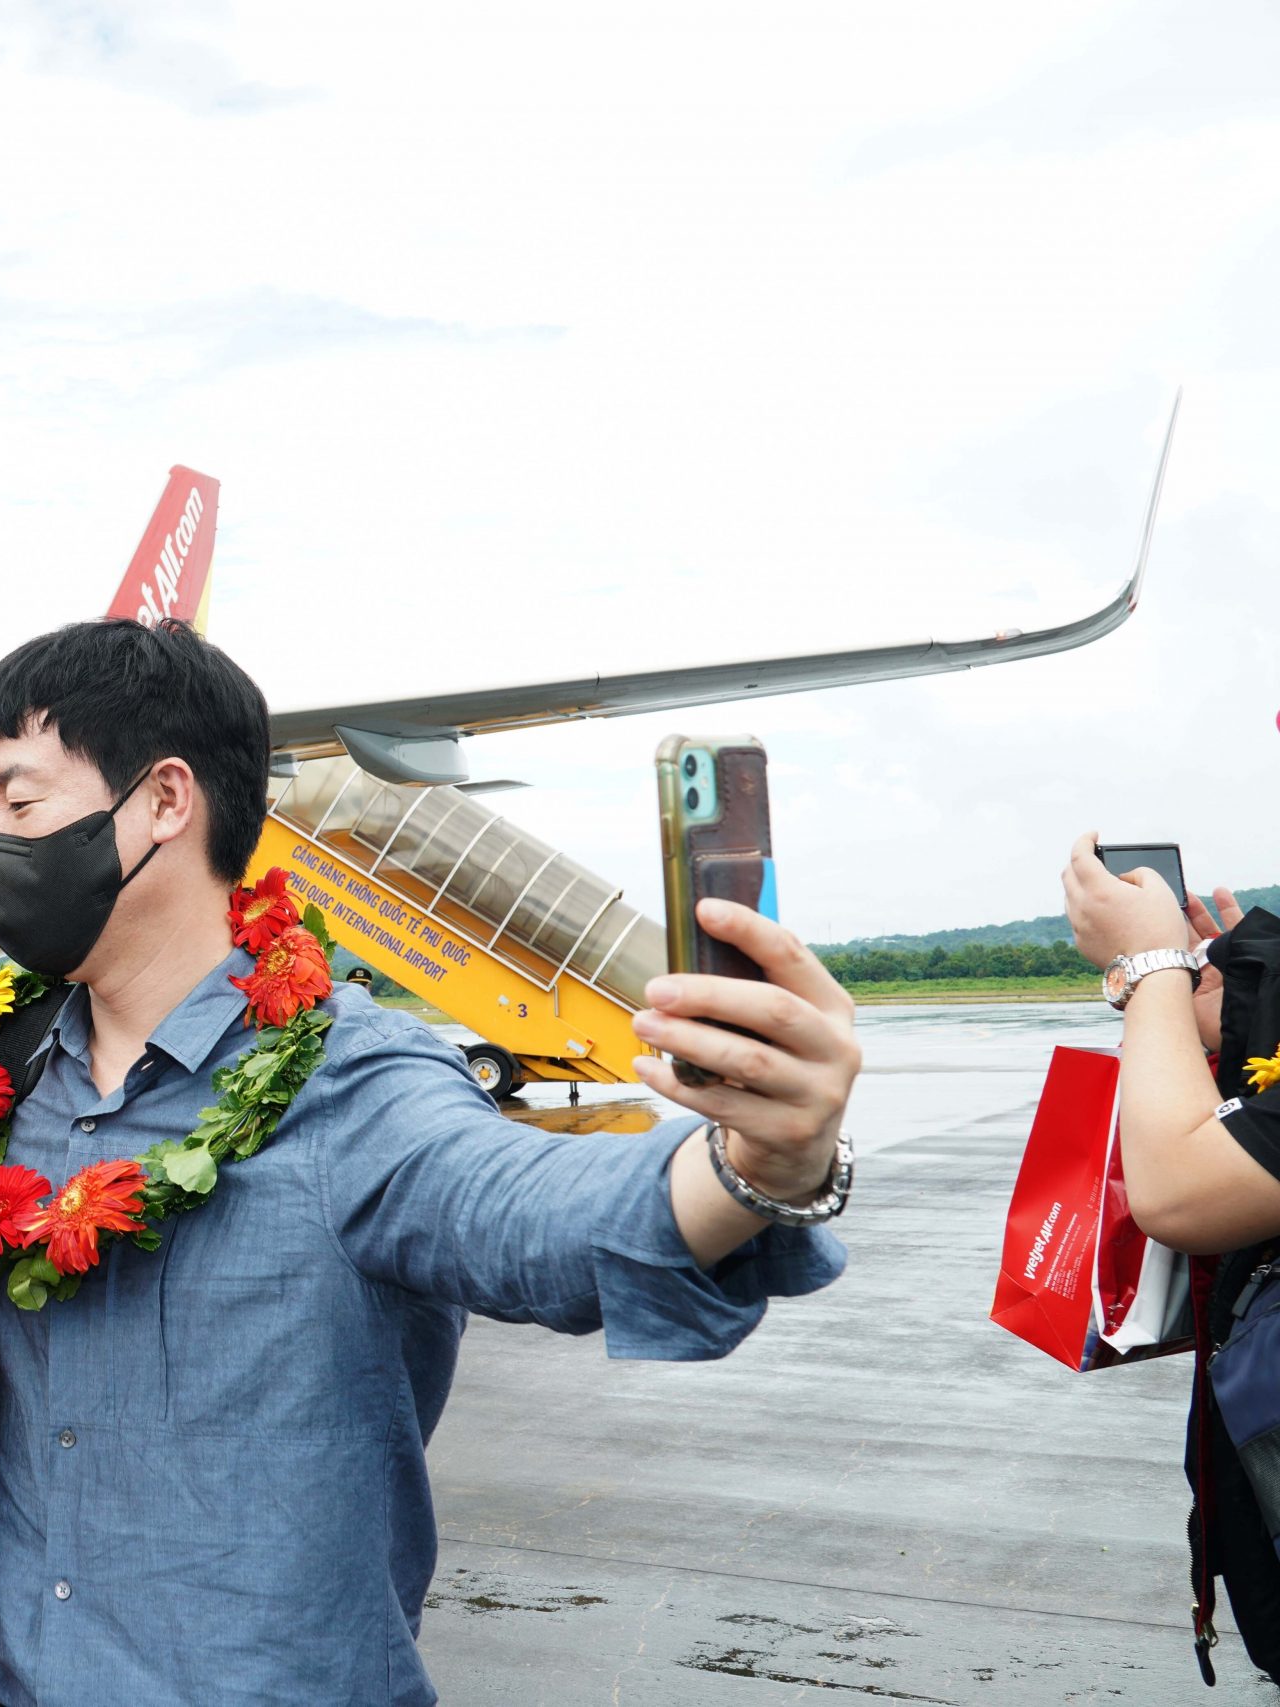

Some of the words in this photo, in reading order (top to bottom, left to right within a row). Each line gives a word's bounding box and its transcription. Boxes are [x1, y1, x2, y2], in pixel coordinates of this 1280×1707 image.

[286, 870, 308, 893] PHU
[306, 885, 335, 910] QUOC
[332, 902, 406, 960] INTERNATIONAL
[402, 947, 448, 983] AIRPORT
[291, 843, 319, 869] CẢNG
[317, 858, 347, 887] HÀNG
[345, 878, 380, 908] KHÔNG
[378, 899, 408, 926] QUỐC
[419, 926, 443, 948] PHÚ
[442, 940, 471, 967] QUỐC
[517, 1003, 528, 1018] 3
